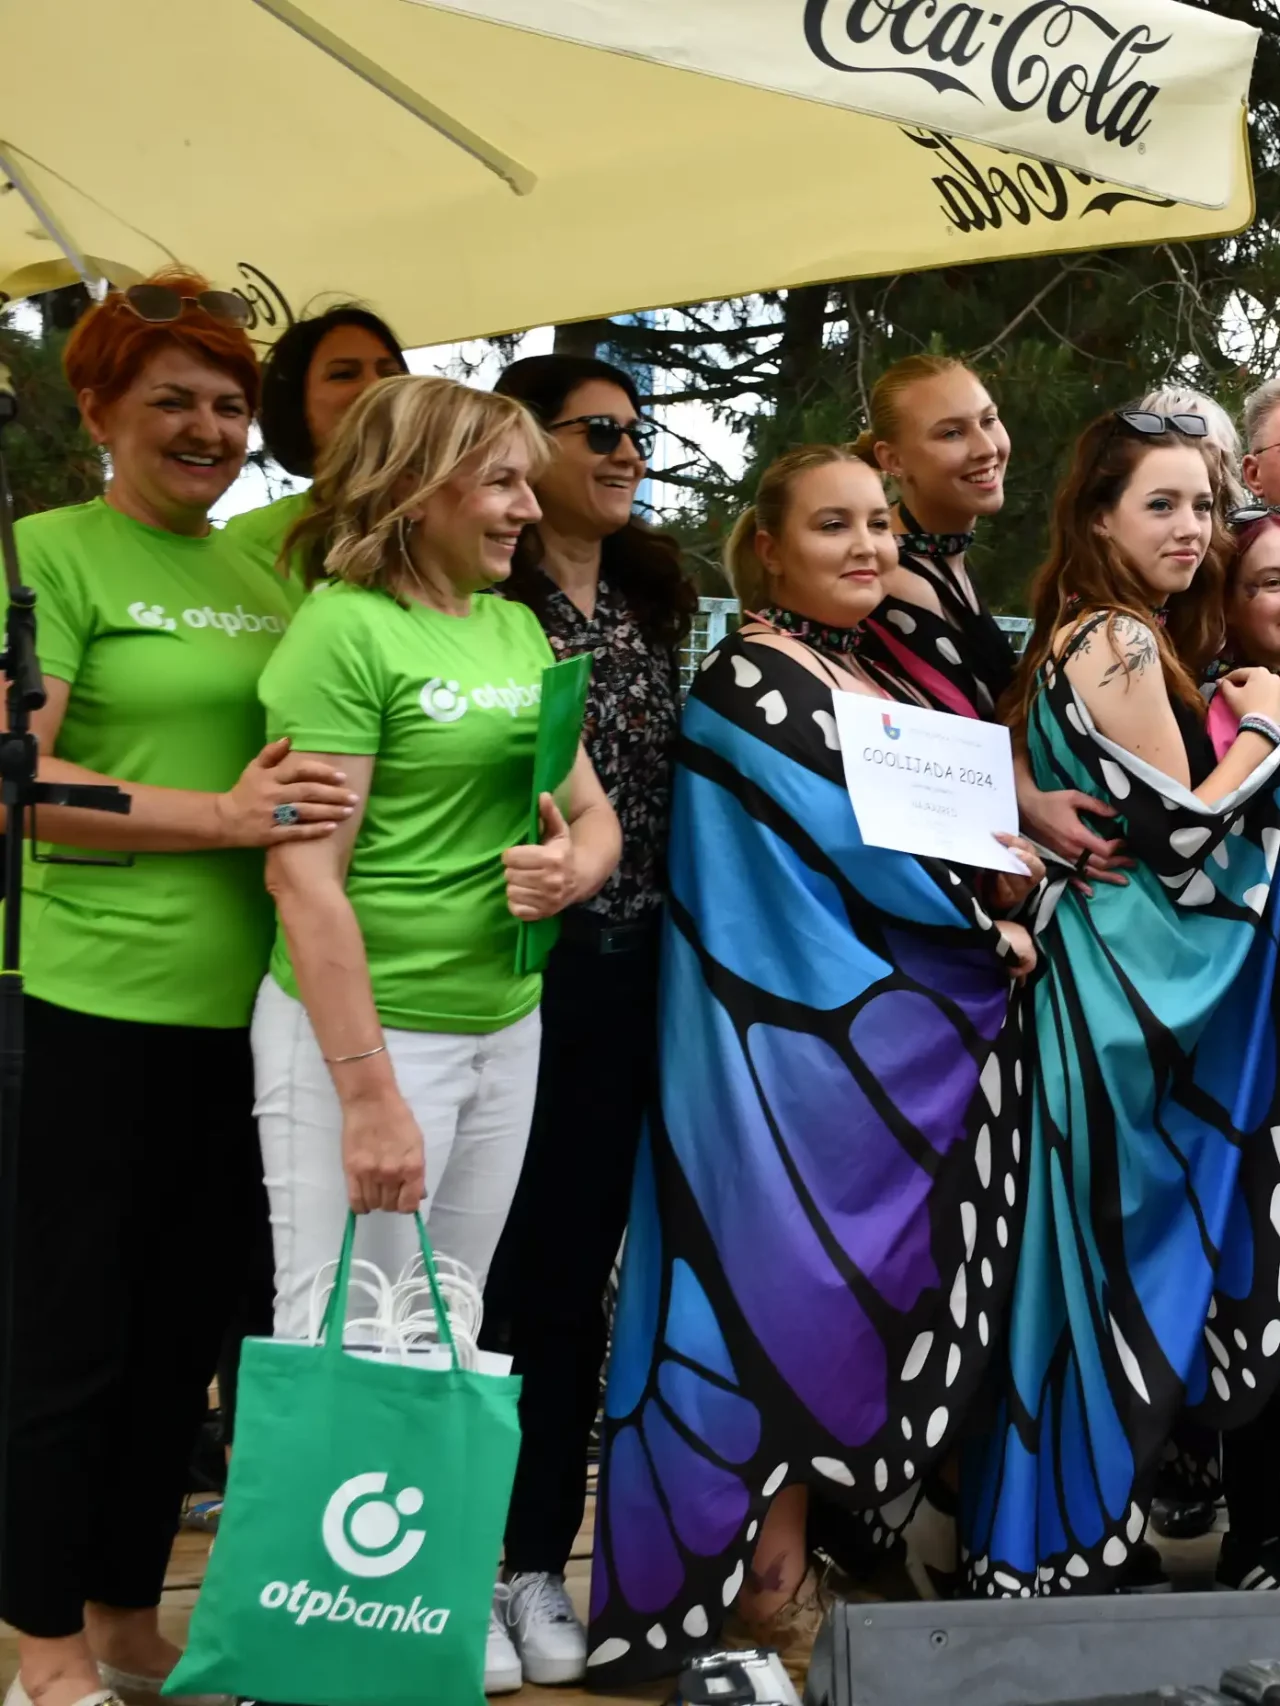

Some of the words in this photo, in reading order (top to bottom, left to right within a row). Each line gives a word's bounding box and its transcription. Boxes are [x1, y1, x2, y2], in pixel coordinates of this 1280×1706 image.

[803, 0, 1173, 148] Coca-Cola
[182, 604, 287, 637] otpba
[863, 747, 954, 781] COOLIJADA
[259, 1579, 451, 1635] otpbanka
